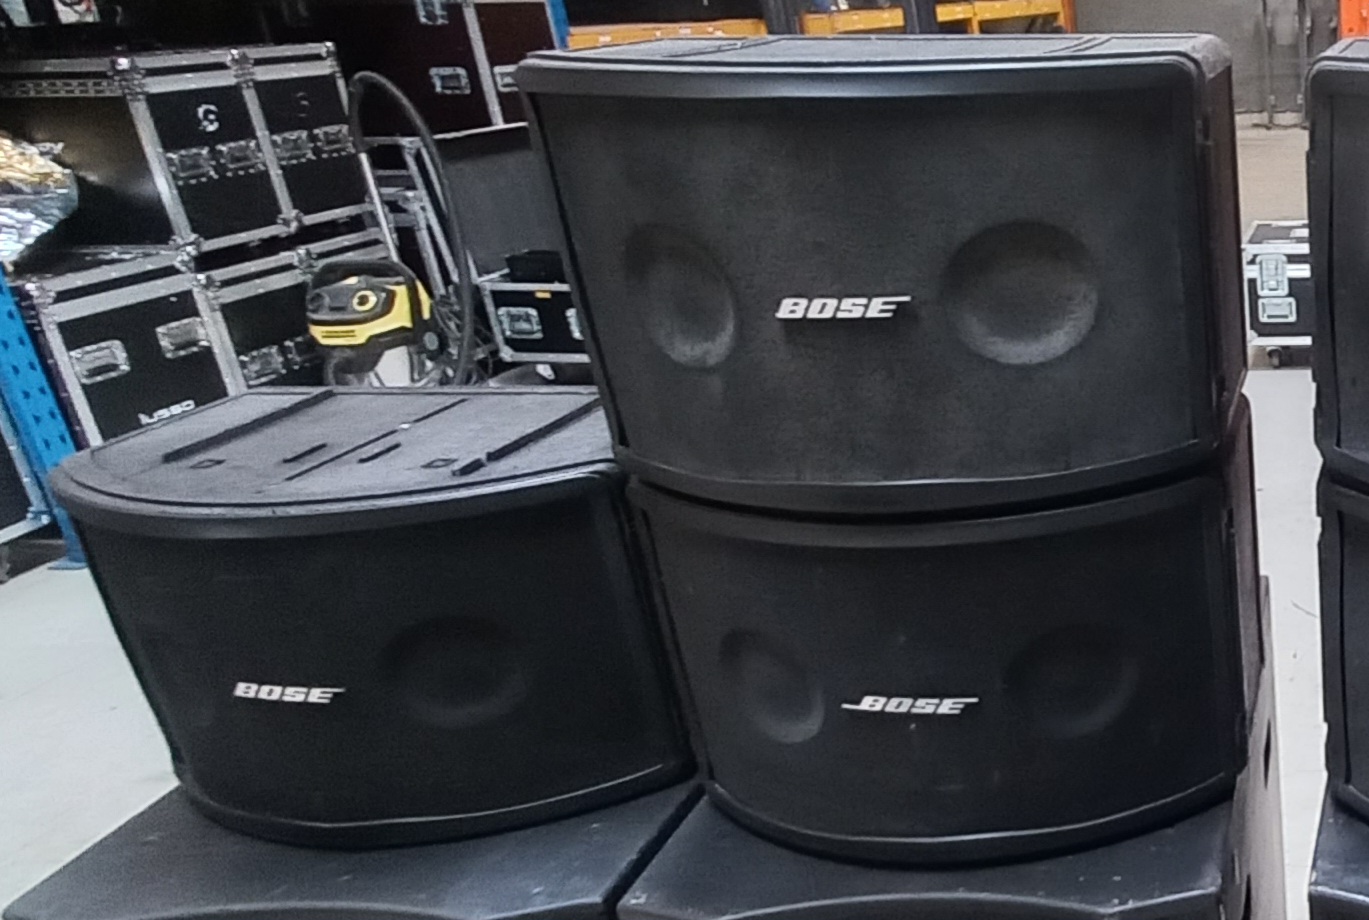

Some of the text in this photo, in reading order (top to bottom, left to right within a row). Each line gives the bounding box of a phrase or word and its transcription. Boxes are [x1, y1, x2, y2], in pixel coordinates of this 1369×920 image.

[775, 295, 911, 319] BOSE
[232, 681, 346, 704] BOSE
[841, 695, 979, 715] BOSE
